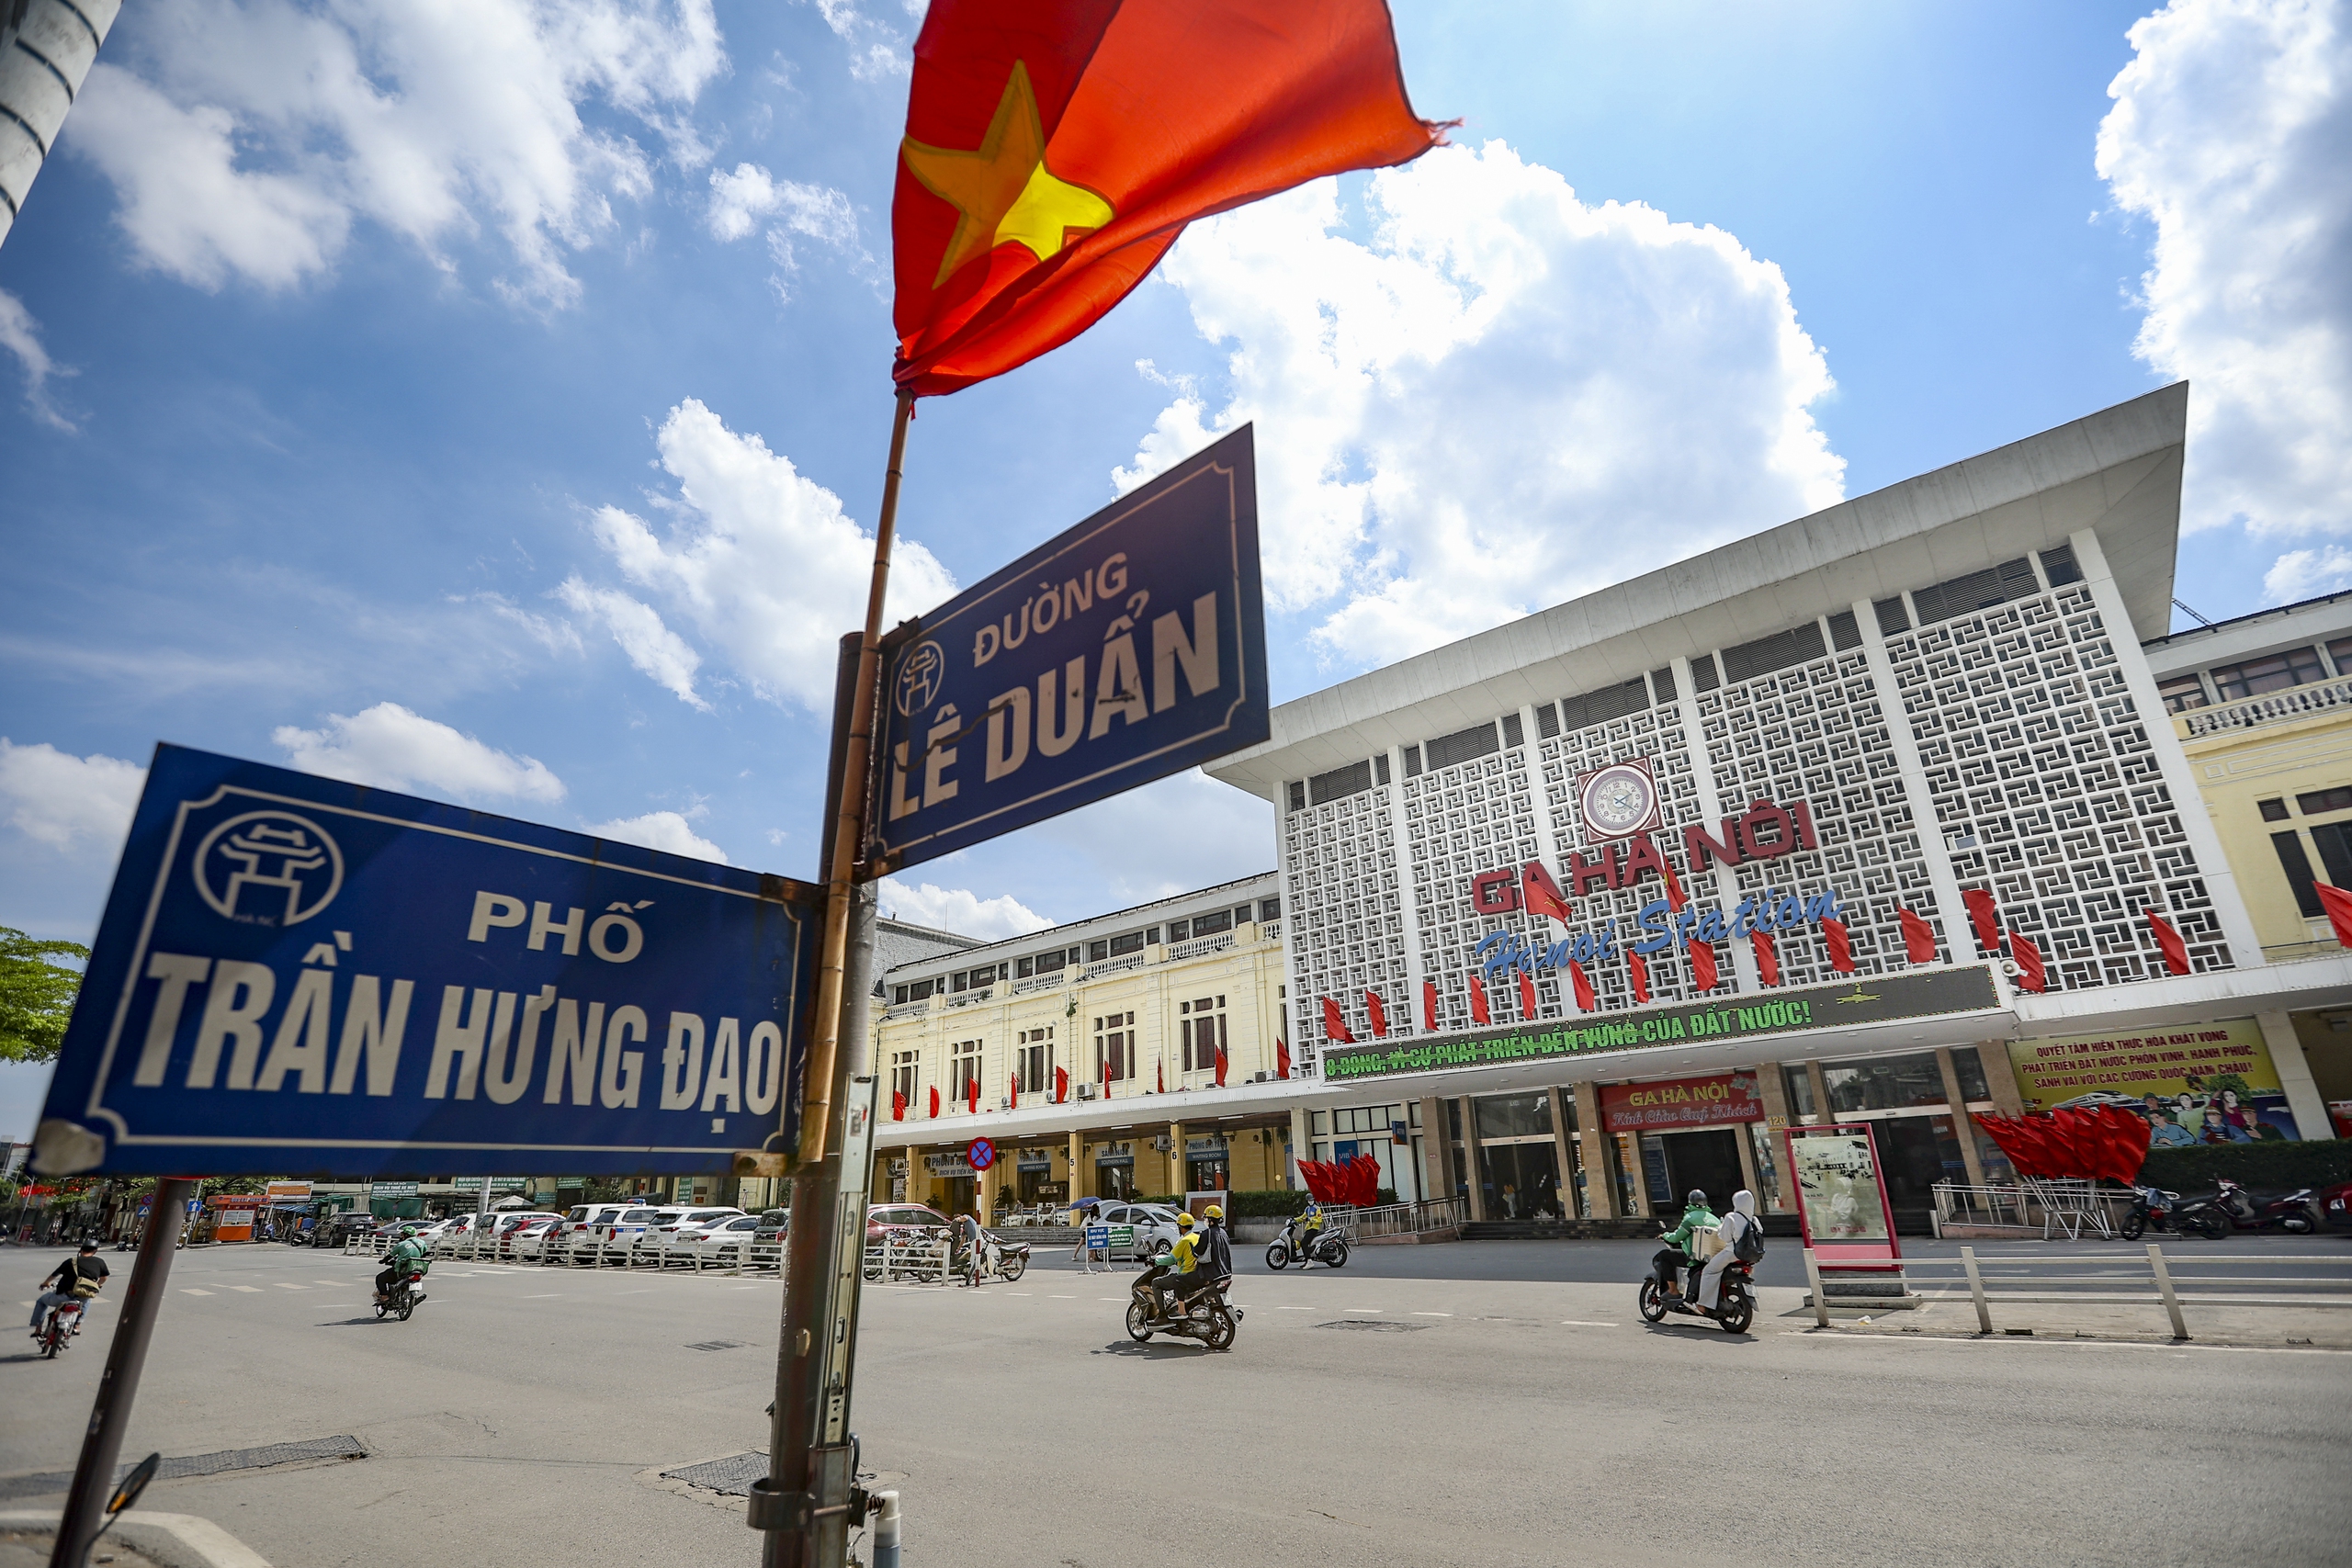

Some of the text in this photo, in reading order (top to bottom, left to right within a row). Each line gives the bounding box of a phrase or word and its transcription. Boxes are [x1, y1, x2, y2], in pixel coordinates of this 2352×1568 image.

[972, 552, 1127, 668] ĐƯỜNG
[888, 589, 1220, 821] LÊ DUẨN
[1473, 798, 1817, 915] GA HÀ NỘI
[468, 889, 654, 964] PHỐ
[1476, 888, 1845, 979] Hanoi Station
[133, 931, 783, 1134] TRẦN HƯNG ĐẠO
[1642, 1011, 1687, 1042] CỦA
[1690, 1004, 1730, 1037] ĐẤT
[1738, 998, 1813, 1031] NƯỚC!
[2037, 1043, 2066, 1058] QUYẾT
[2068, 1041, 2090, 1055] TÂM
[2091, 1039, 2116, 1054] HIỆN
[2117, 1037, 2143, 1051] THỰC
[2197, 1030, 2228, 1044] VỌNG
[2190, 1047, 2221, 1062] HẠNH
[2063, 1076, 2079, 1087] VAI
[2218, 1060, 2255, 1074] CHÂU!
[1630, 1082, 1729, 1106] GA HÀ NỘI
[1611, 1102, 1757, 1126] Kính Chào Quý Khách
[1767, 1115, 1787, 1127] 120
[1070, 1158, 1075, 1167] 5
[1172, 1151, 1177, 1159] 6
